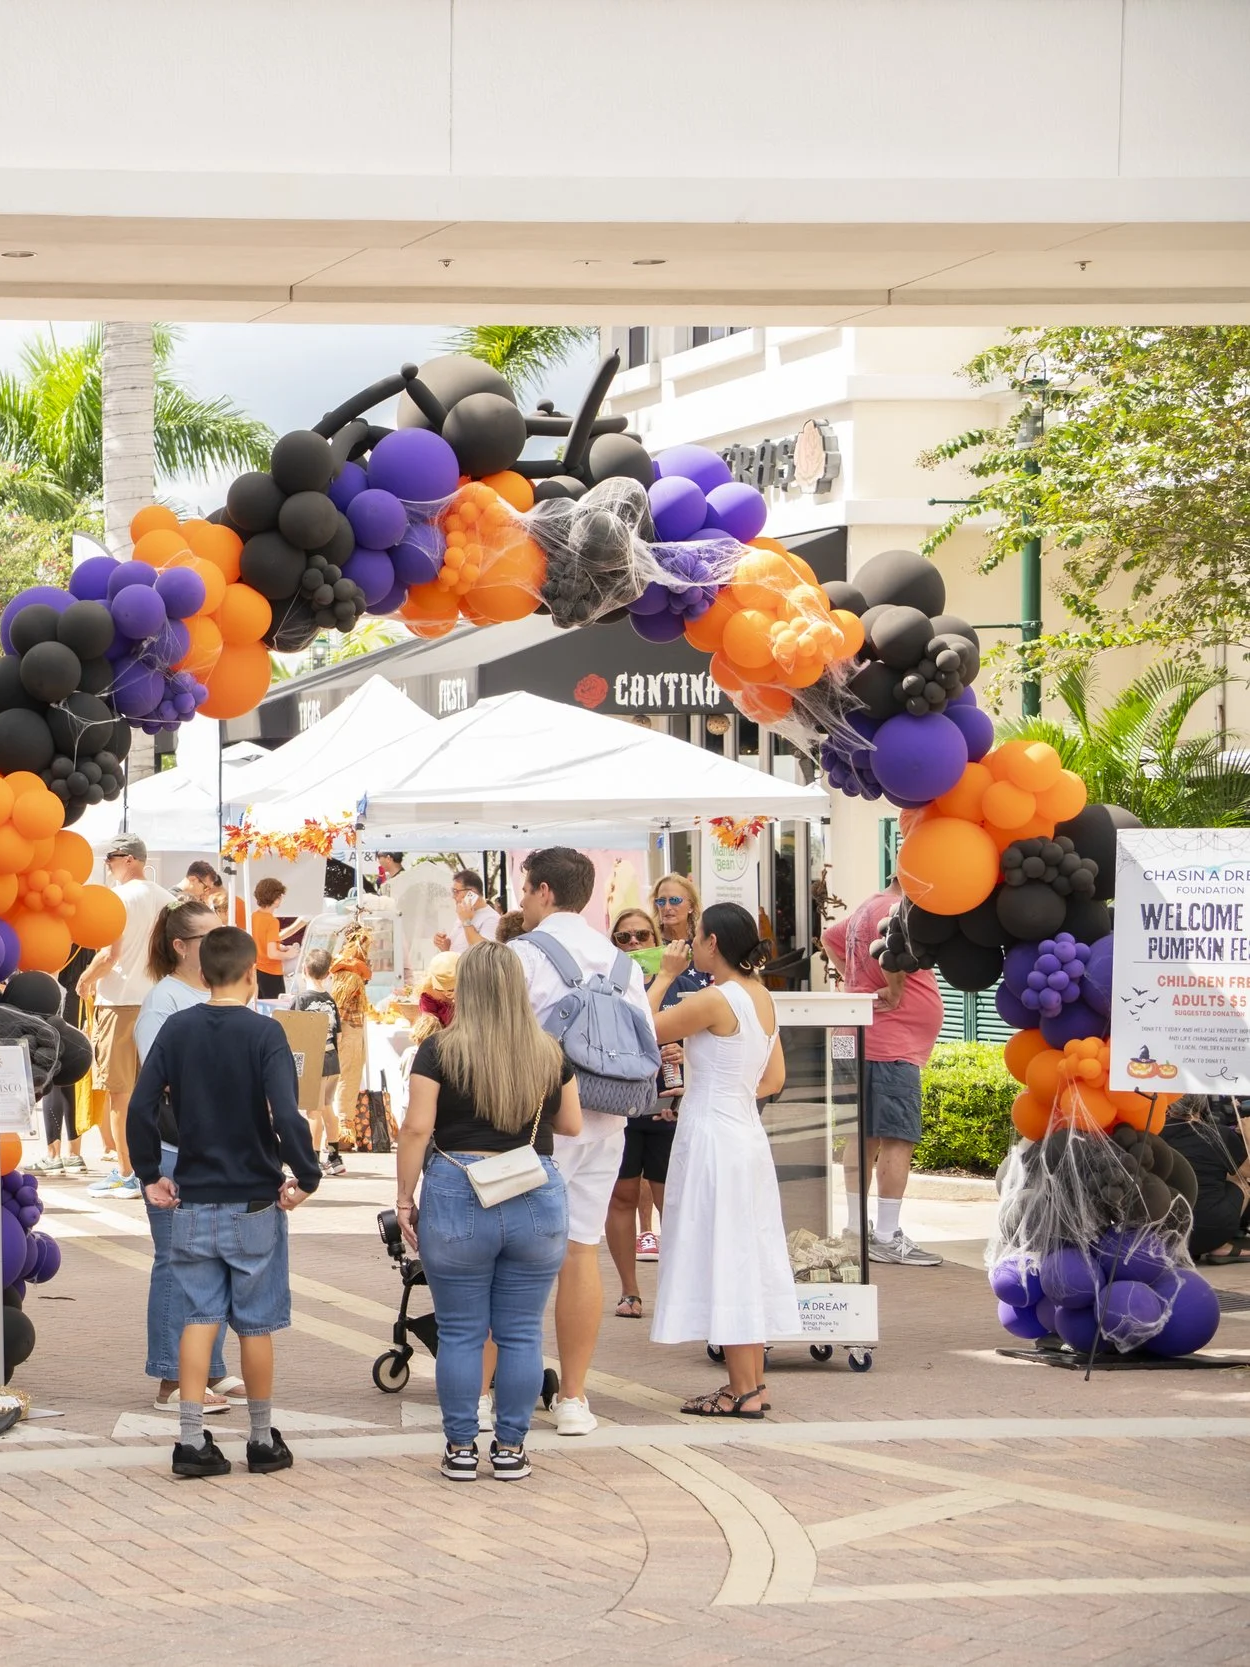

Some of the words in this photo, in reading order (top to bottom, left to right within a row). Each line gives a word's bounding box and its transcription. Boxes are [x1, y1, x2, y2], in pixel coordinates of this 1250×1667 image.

[614, 671, 721, 708] CANTINA
[1143, 870, 1205, 881] CHASIN
[1208, 870, 1220, 881] A
[1176, 886, 1245, 894] FOUNDATION
[1140, 902, 1244, 932] WELCOME
[1148, 936, 1224, 961] PUMPKIN
[1231, 937, 1250, 961] FE
[1157, 975, 1224, 988] CHILDREN
[1172, 994, 1225, 1007] ADULTS
[1229, 995, 1247, 1008] $5
[802, 1302, 810, 1311] A
[812, 1302, 848, 1311] DREAM
